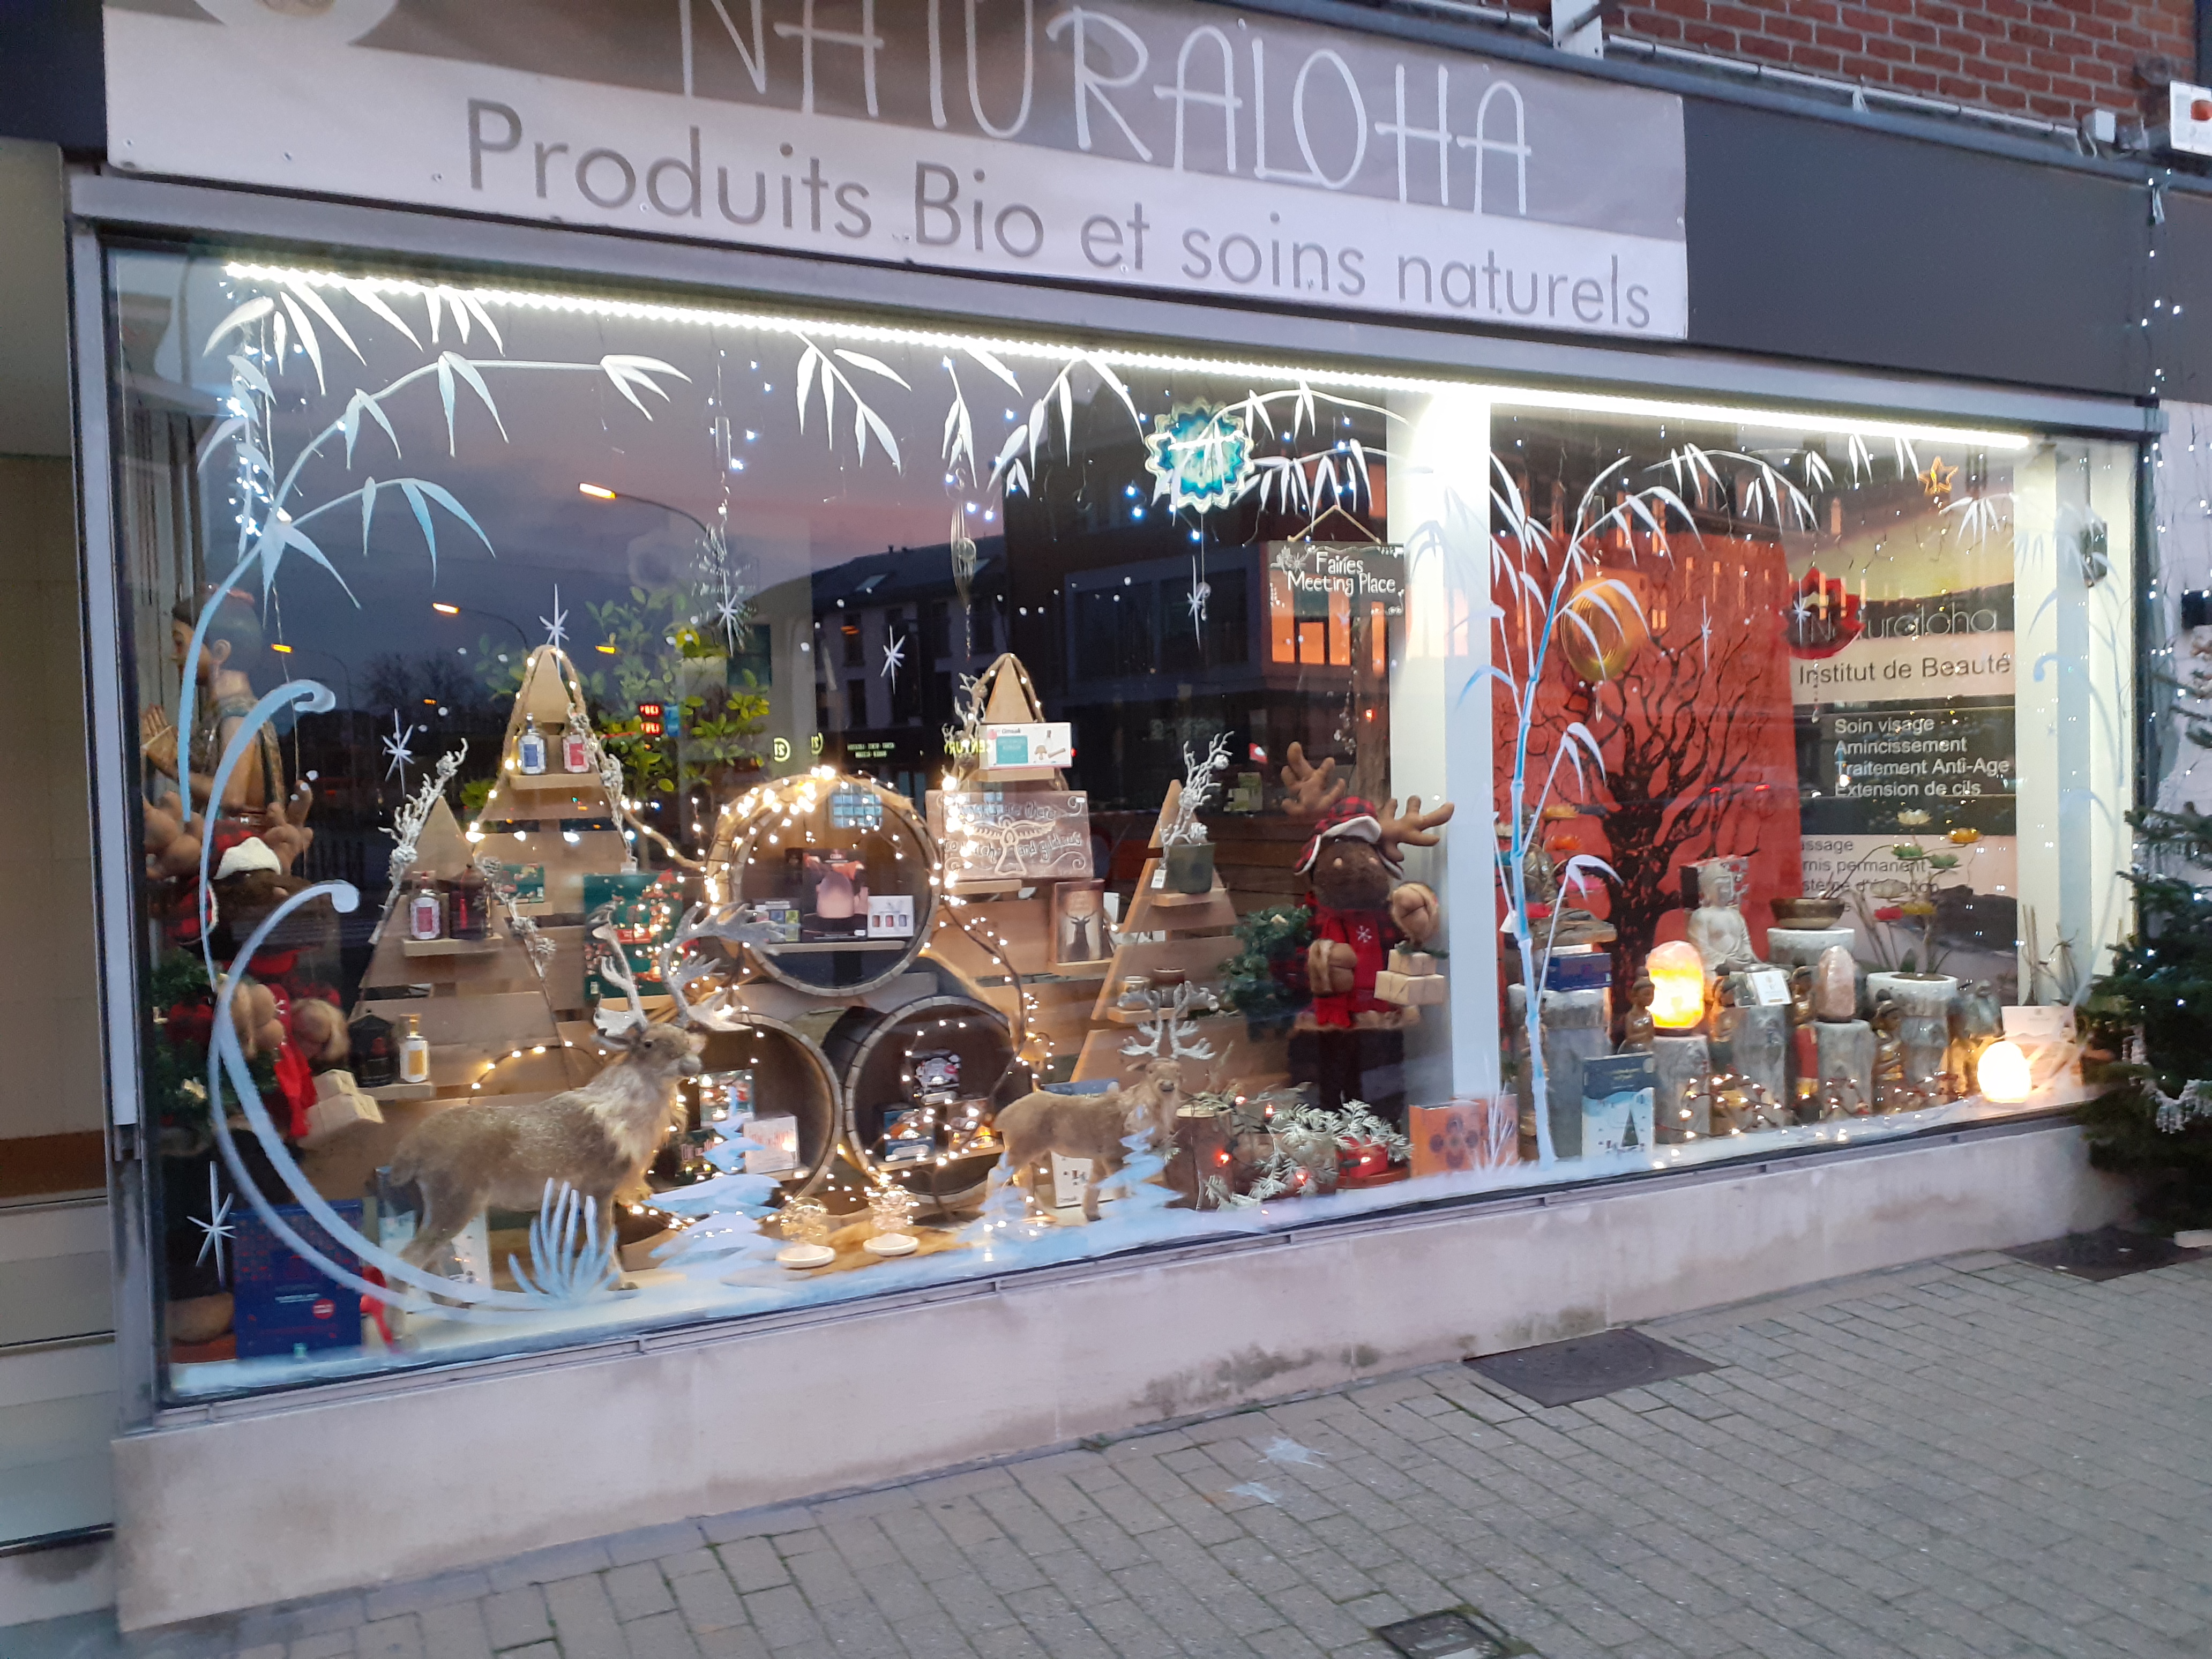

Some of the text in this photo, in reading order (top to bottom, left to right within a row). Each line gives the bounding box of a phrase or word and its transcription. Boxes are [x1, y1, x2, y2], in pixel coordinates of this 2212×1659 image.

[466, 98, 1651, 328] Produits Bio et soins naturels
[1316, 551, 1364, 574] Fairies
[1287, 571, 1396, 597] Meeting Place
[1798, 652, 2011, 685] Institut de Beauté
[1835, 717, 1935, 736] Soin visage
[1834, 736, 1968, 756] Amincissement
[1835, 757, 2010, 777] Traitement Anti-Age
[1835, 779, 1982, 798] Extension de cils
[1837, 858, 1926, 875] permanent
